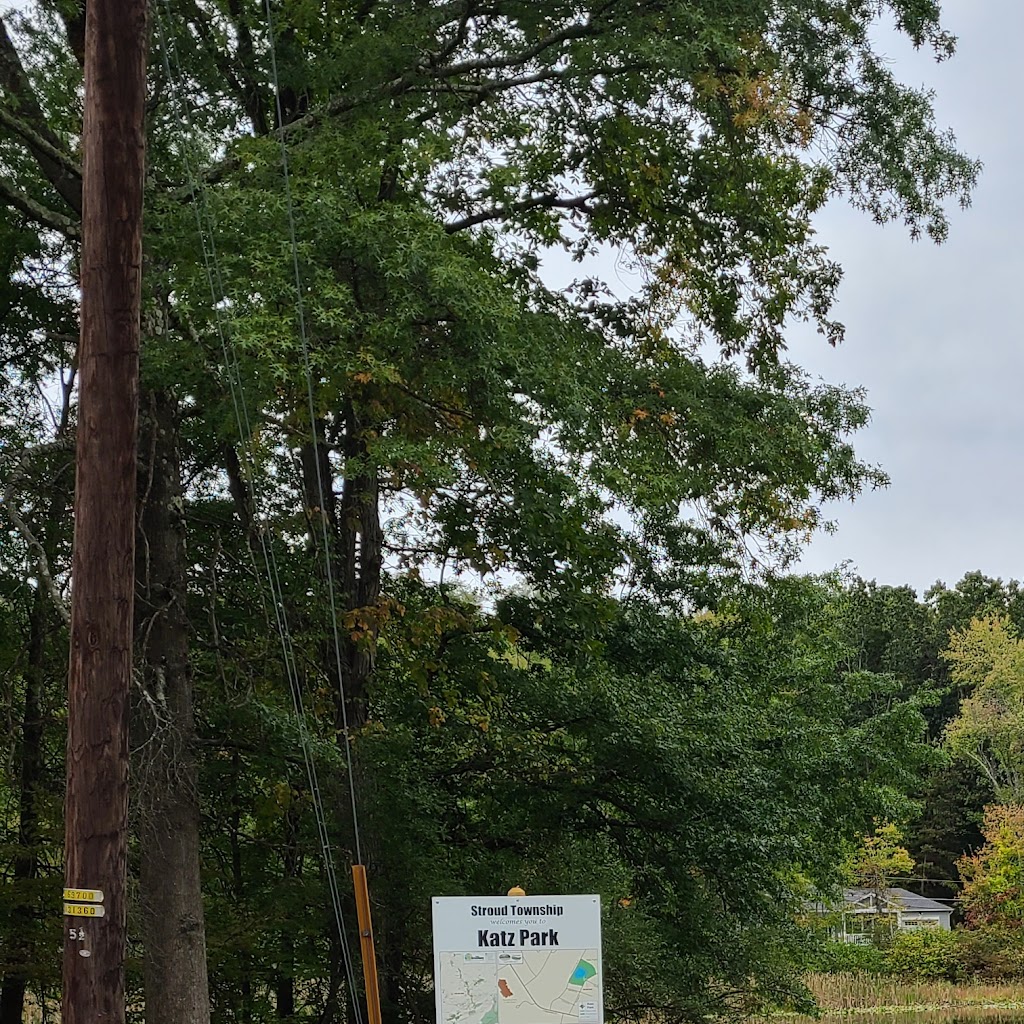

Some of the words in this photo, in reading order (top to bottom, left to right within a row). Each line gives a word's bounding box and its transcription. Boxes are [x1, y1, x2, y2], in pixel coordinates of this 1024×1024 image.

[471, 905, 508, 916] Stroud
[511, 905, 563, 916] Township
[478, 930, 515, 947] Katz
[520, 929, 559, 946] Park
